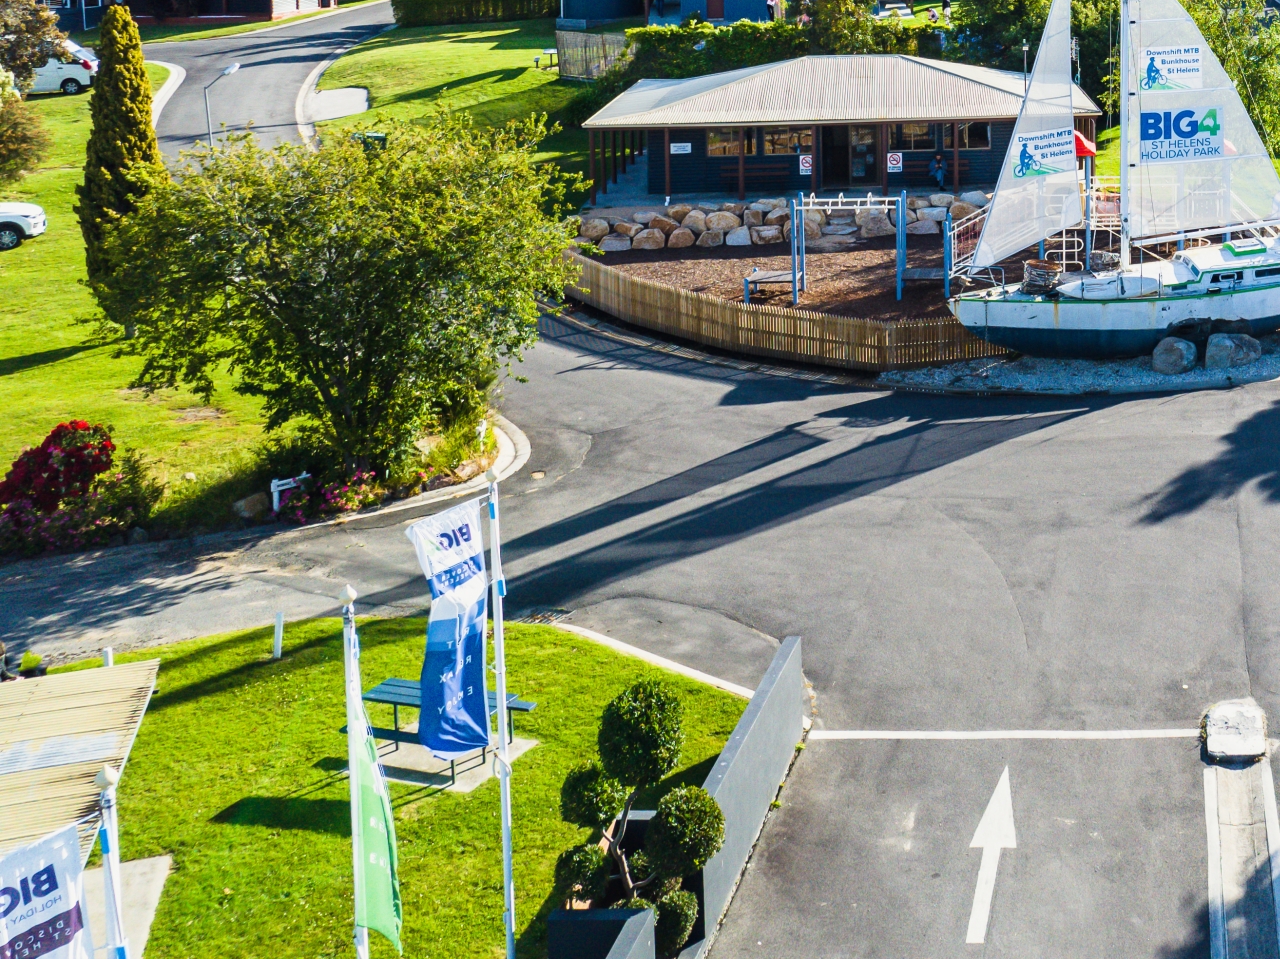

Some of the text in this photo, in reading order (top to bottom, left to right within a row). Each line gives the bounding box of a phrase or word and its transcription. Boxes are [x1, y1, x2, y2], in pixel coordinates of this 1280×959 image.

[1140, 108, 1220, 141] BIG4
[1018, 133, 1055, 142] Downshift
[1034, 140, 1072, 150] Bunkhouse
[1151, 138, 1211, 149] ST HELENS
[1050, 149, 1073, 158] Helens
[1141, 146, 1221, 160] HOLIDAY PARK
